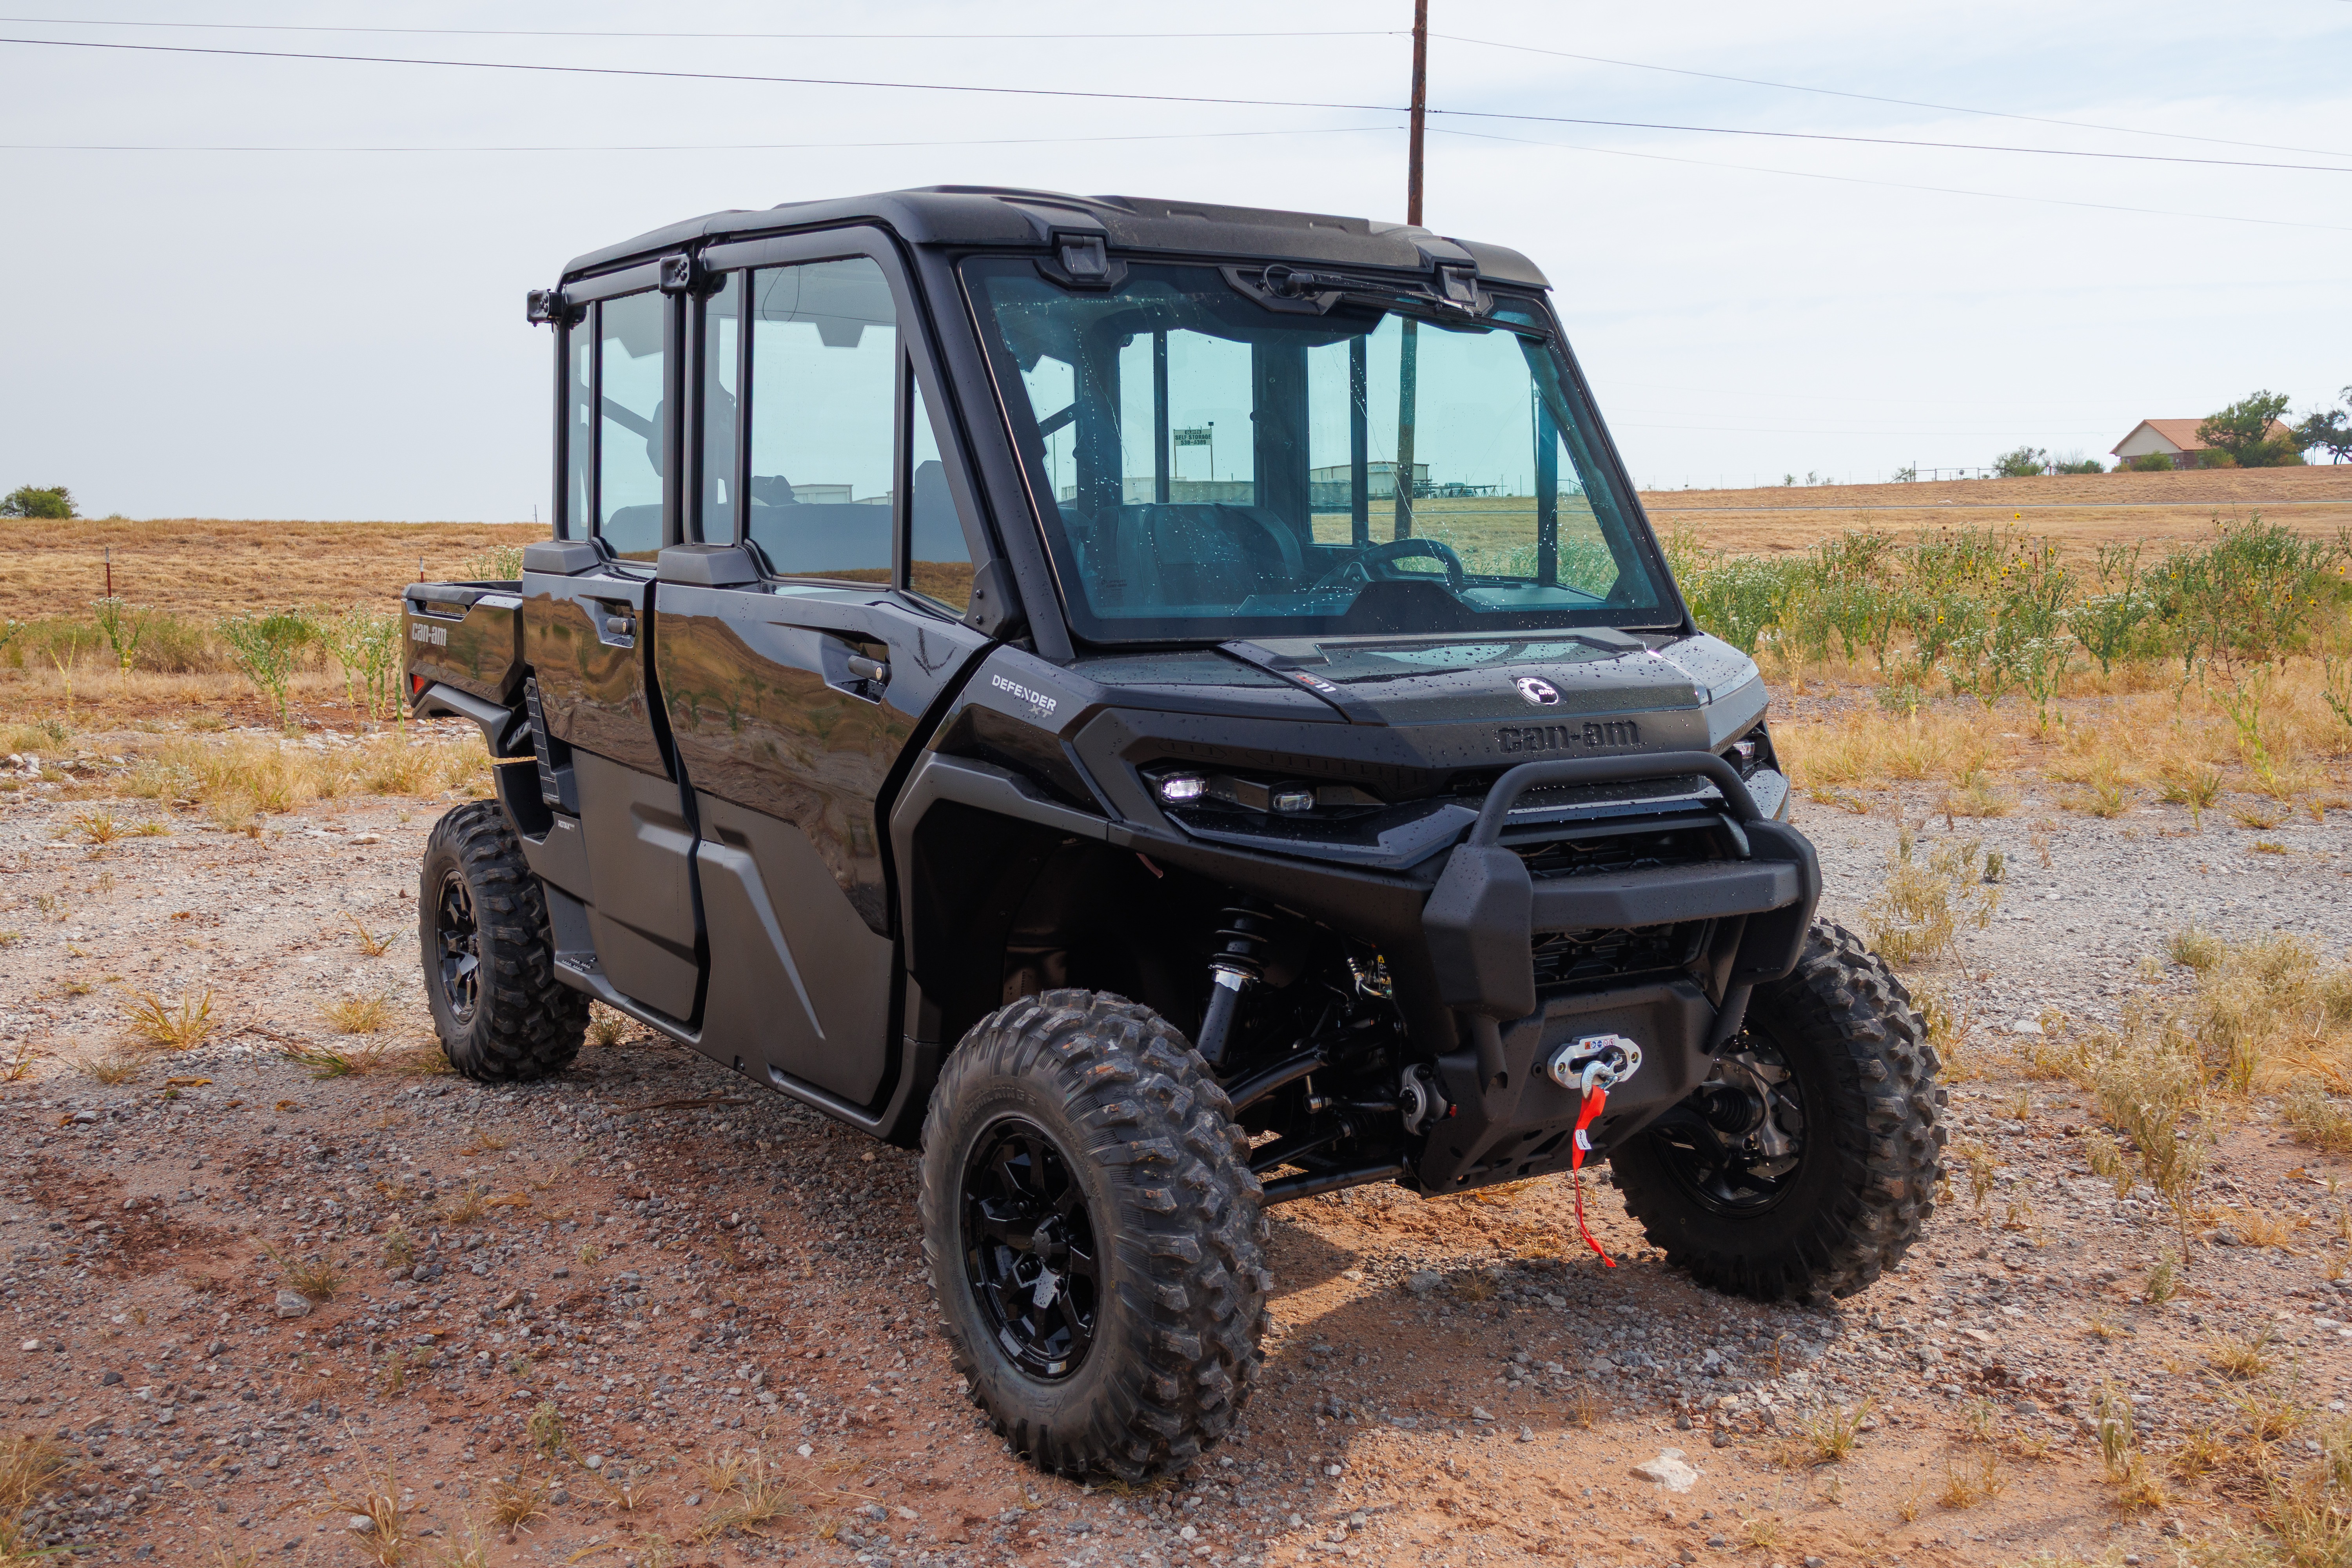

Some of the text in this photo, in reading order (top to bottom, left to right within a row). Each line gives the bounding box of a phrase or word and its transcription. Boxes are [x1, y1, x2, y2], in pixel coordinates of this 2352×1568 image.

[412, 622, 447, 646] can-am
[992, 674, 1057, 711] DEFENDER
[1029, 704, 1053, 718] XT
[1497, 720, 1641, 755] can-am
[558, 820, 570, 830] ROTAX
[960, 1091, 993, 1123] TRAIL
[994, 1087, 1025, 1102] KING
